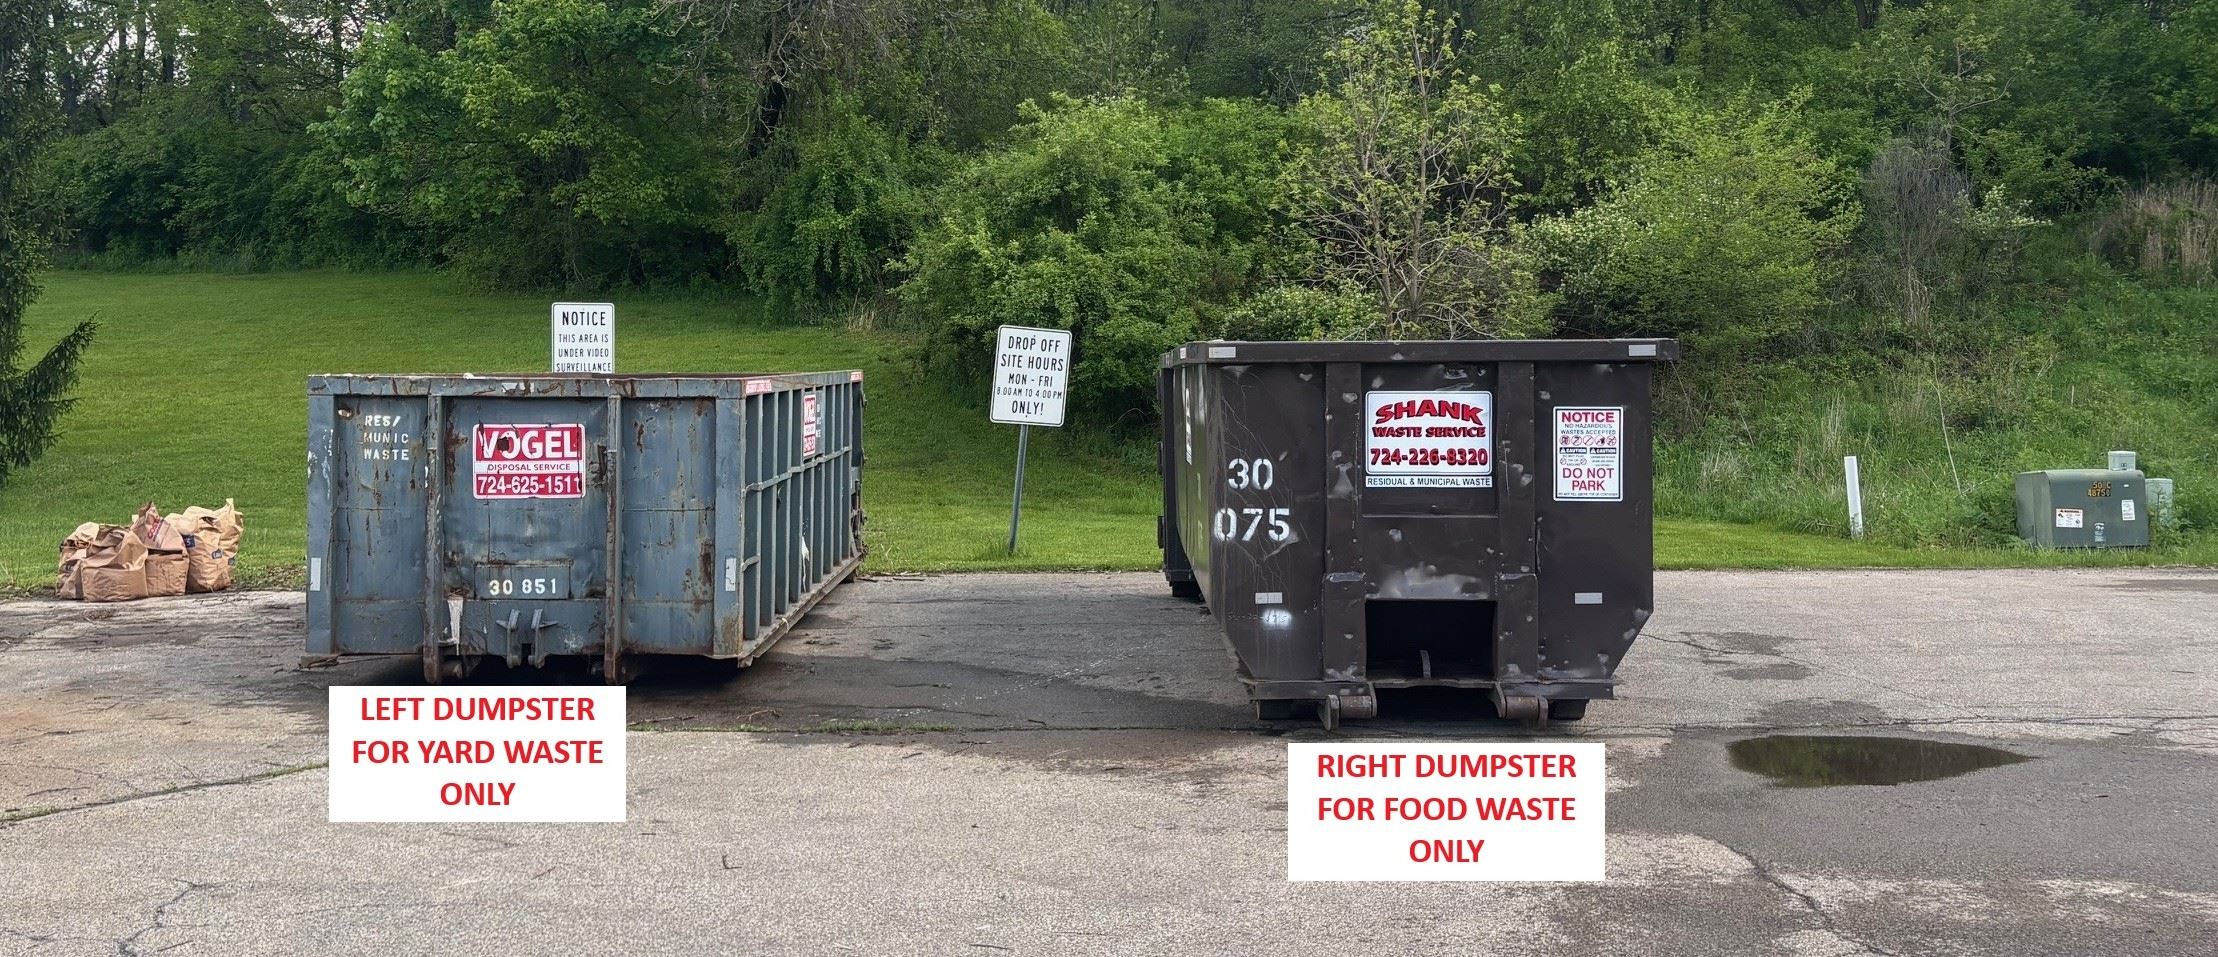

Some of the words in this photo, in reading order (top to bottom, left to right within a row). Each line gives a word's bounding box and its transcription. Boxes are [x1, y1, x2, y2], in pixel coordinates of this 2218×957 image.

[562, 312, 606, 326] NOTICE
[559, 334, 576, 343] THIS
[579, 334, 598, 343] AREA
[602, 334, 609, 343] IS
[1008, 336, 1036, 351] DROP
[1041, 339, 1061, 353] OFF
[558, 348, 584, 358] UNDER
[587, 348, 609, 358] VIDEO
[556, 363, 611, 372] SURVEILLANCE
[1001, 354, 1023, 368] SITE
[1028, 356, 1064, 372] HOURS
[1008, 373, 1027, 385] MON
[1038, 375, 1053, 387] FRI
[1025, 388, 1033, 397] TO
[1012, 400, 1044, 416] ONLY!
[1375, 399, 1484, 426] SHANK
[365, 415, 401, 428] RES/
[1561, 412, 1615, 423] NOTICE
[363, 432, 409, 444] MUNIC
[1372, 426, 1422, 438] WASTE
[1425, 426, 1486, 438] SERVICE
[478, 430, 578, 459] VOGEL
[364, 448, 409, 461] WASTE
[1370, 448, 1489, 466] 724-226-8320
[487, 463, 531, 471] DISPOSAL
[533, 463, 571, 471] SERVICE
[1562, 467, 1583, 479] DO
[1587, 467, 1615, 479] NOT
[1228, 458, 1273, 490] 30
[477, 475, 581, 494] 724-625-1511
[1367, 478, 1407, 486] RESIDUAL
[1409, 478, 1415, 486] &
[1417, 478, 1461, 486] MUNICIPAL
[1462, 478, 1491, 486] WASTE
[1572, 480, 1605, 491] PARK
[1214, 507, 1290, 542] 075
[489, 579, 513, 596] 30
[522, 578, 556, 594] 851
